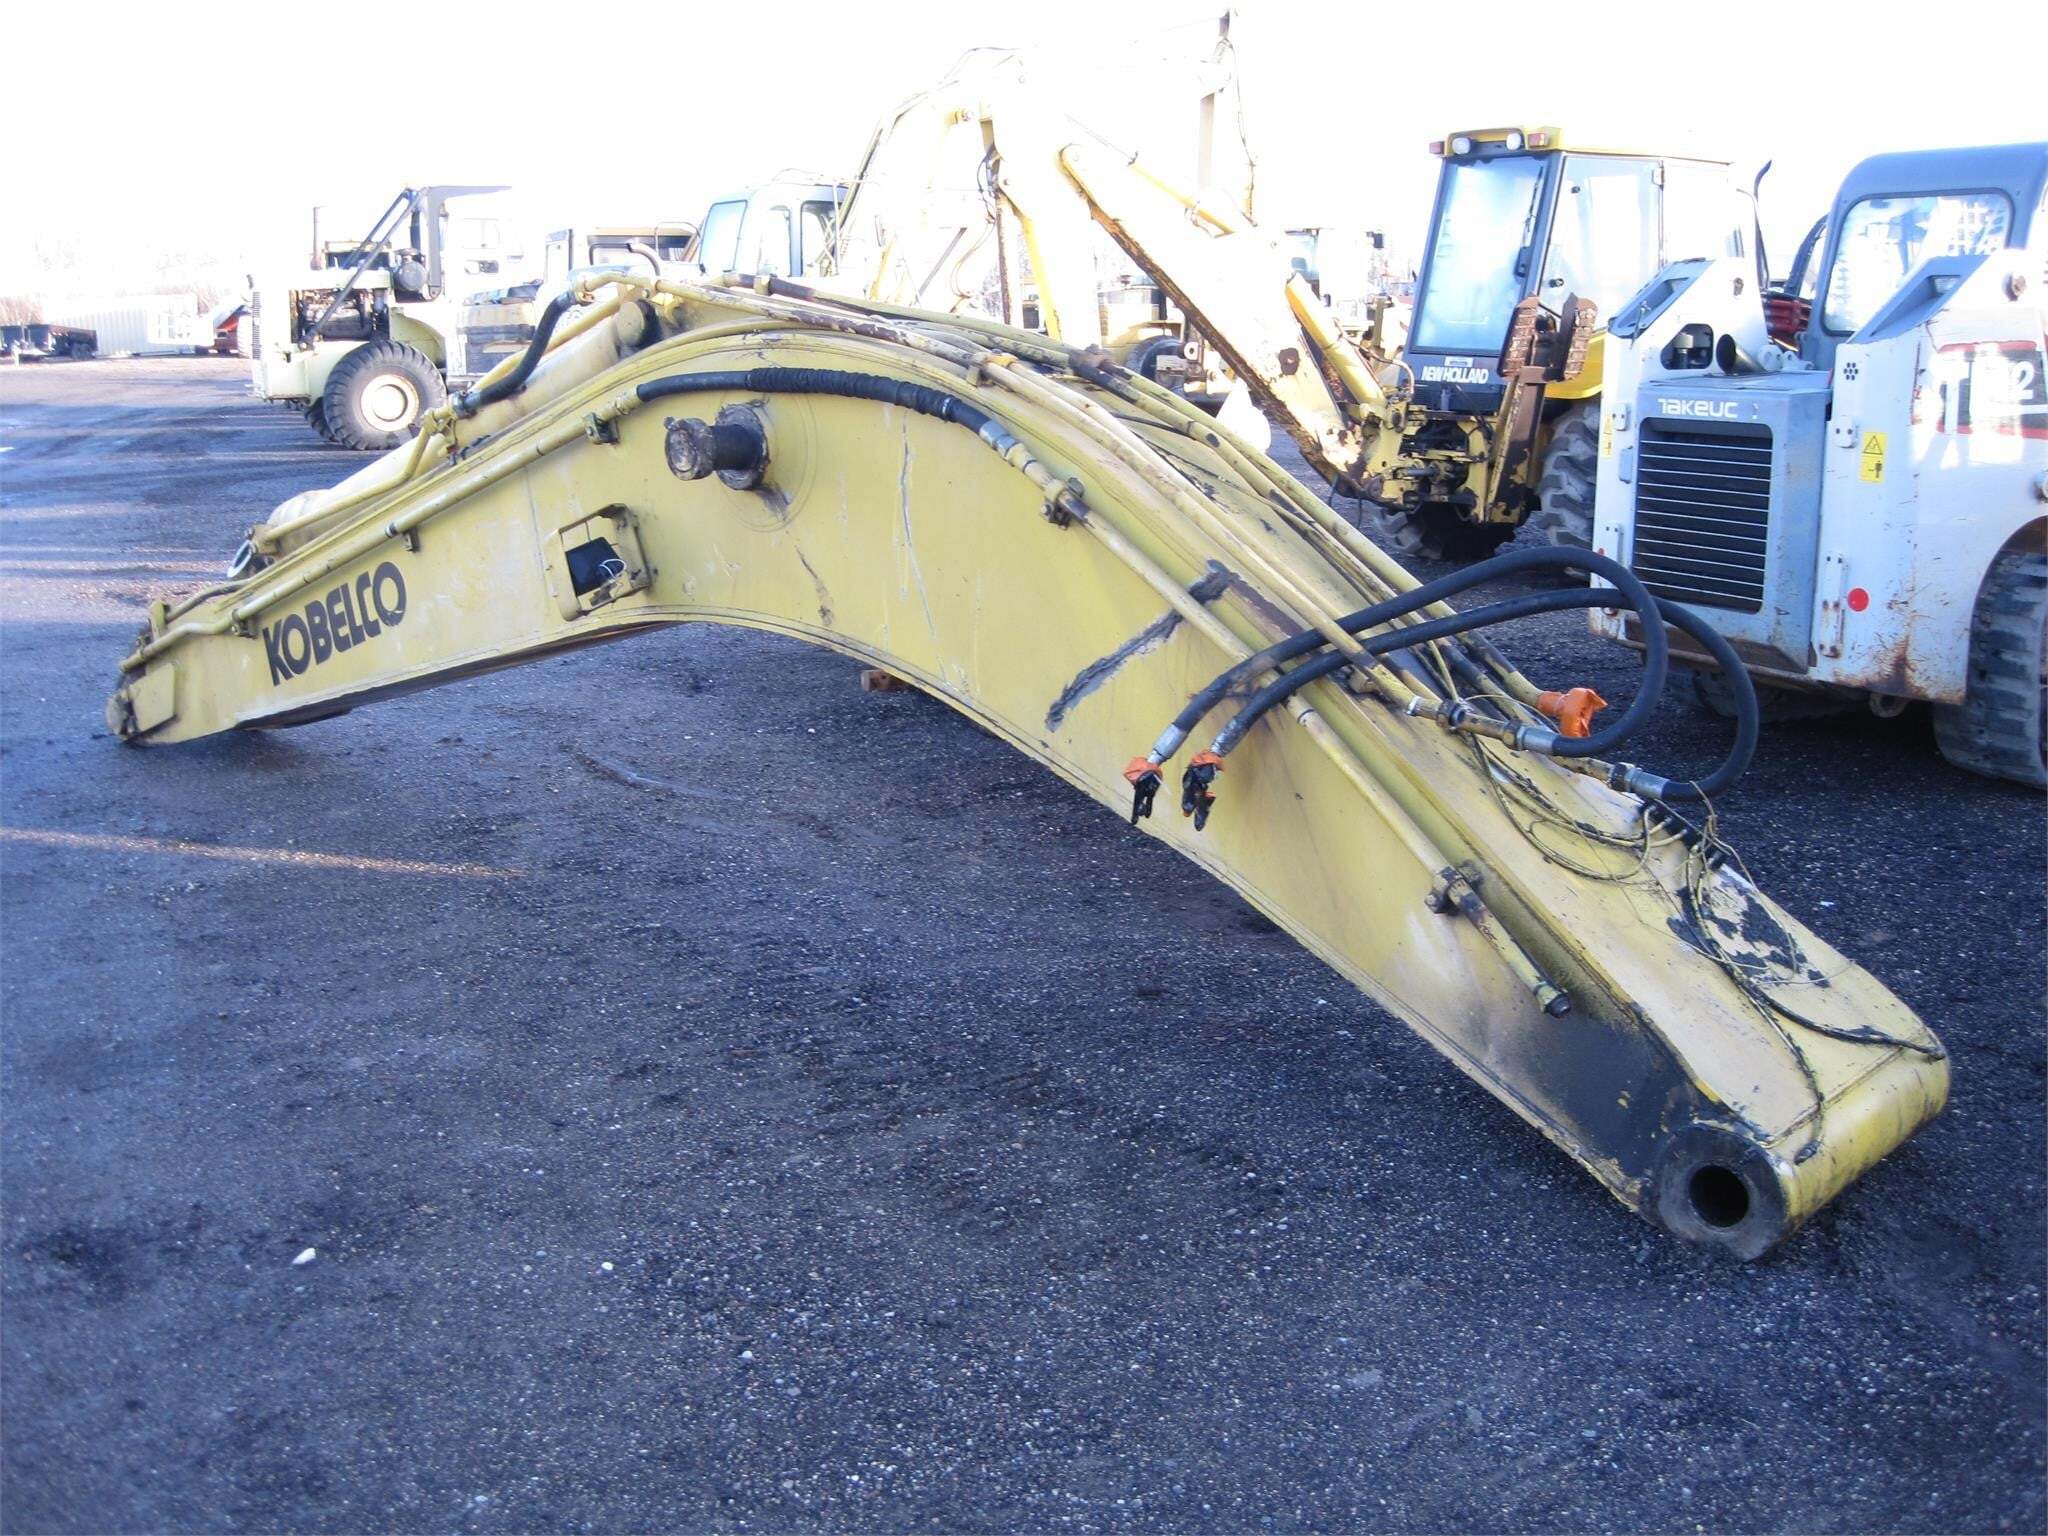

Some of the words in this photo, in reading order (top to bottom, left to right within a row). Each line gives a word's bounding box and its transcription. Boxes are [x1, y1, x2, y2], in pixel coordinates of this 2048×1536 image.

[1421, 366, 1443, 381] NEW
[1444, 367, 1489, 384] HOLLAND
[262, 562, 407, 687] KOBELCO
